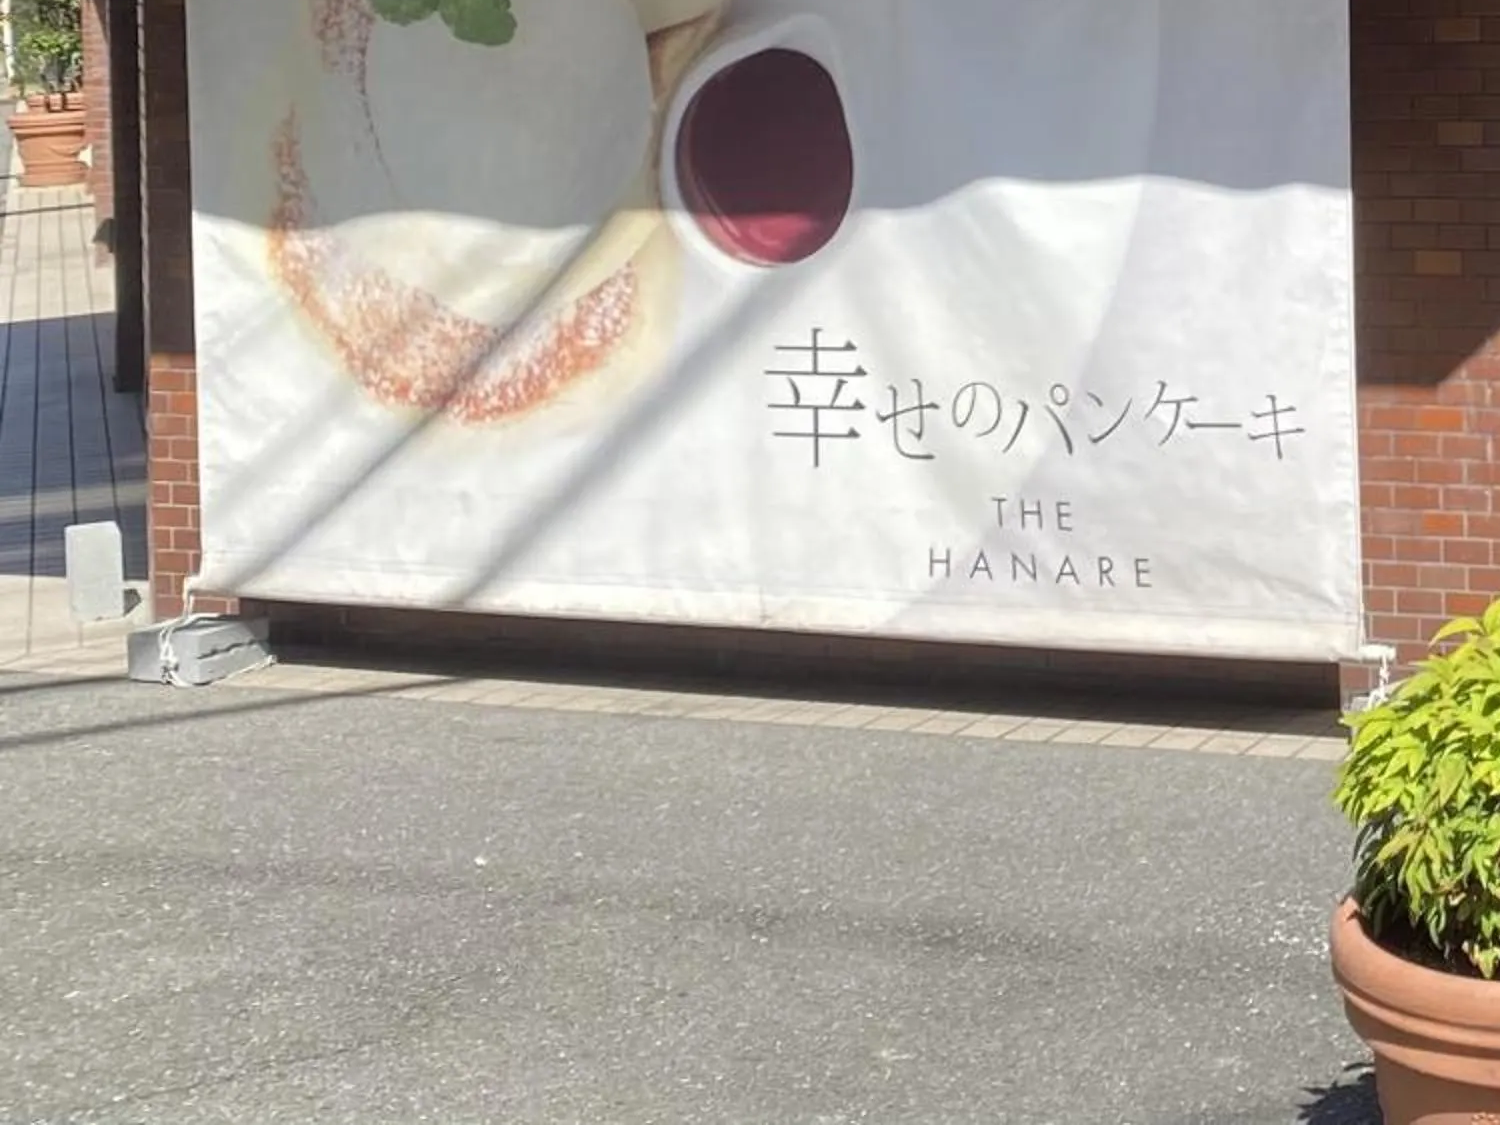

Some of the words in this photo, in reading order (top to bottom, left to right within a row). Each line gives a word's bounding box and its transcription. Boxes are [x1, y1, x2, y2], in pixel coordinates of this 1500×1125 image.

[763, 327, 1306, 468] 幸せのパンケーキ
[991, 496, 1074, 532] THE
[928, 547, 1153, 588] HANARE
